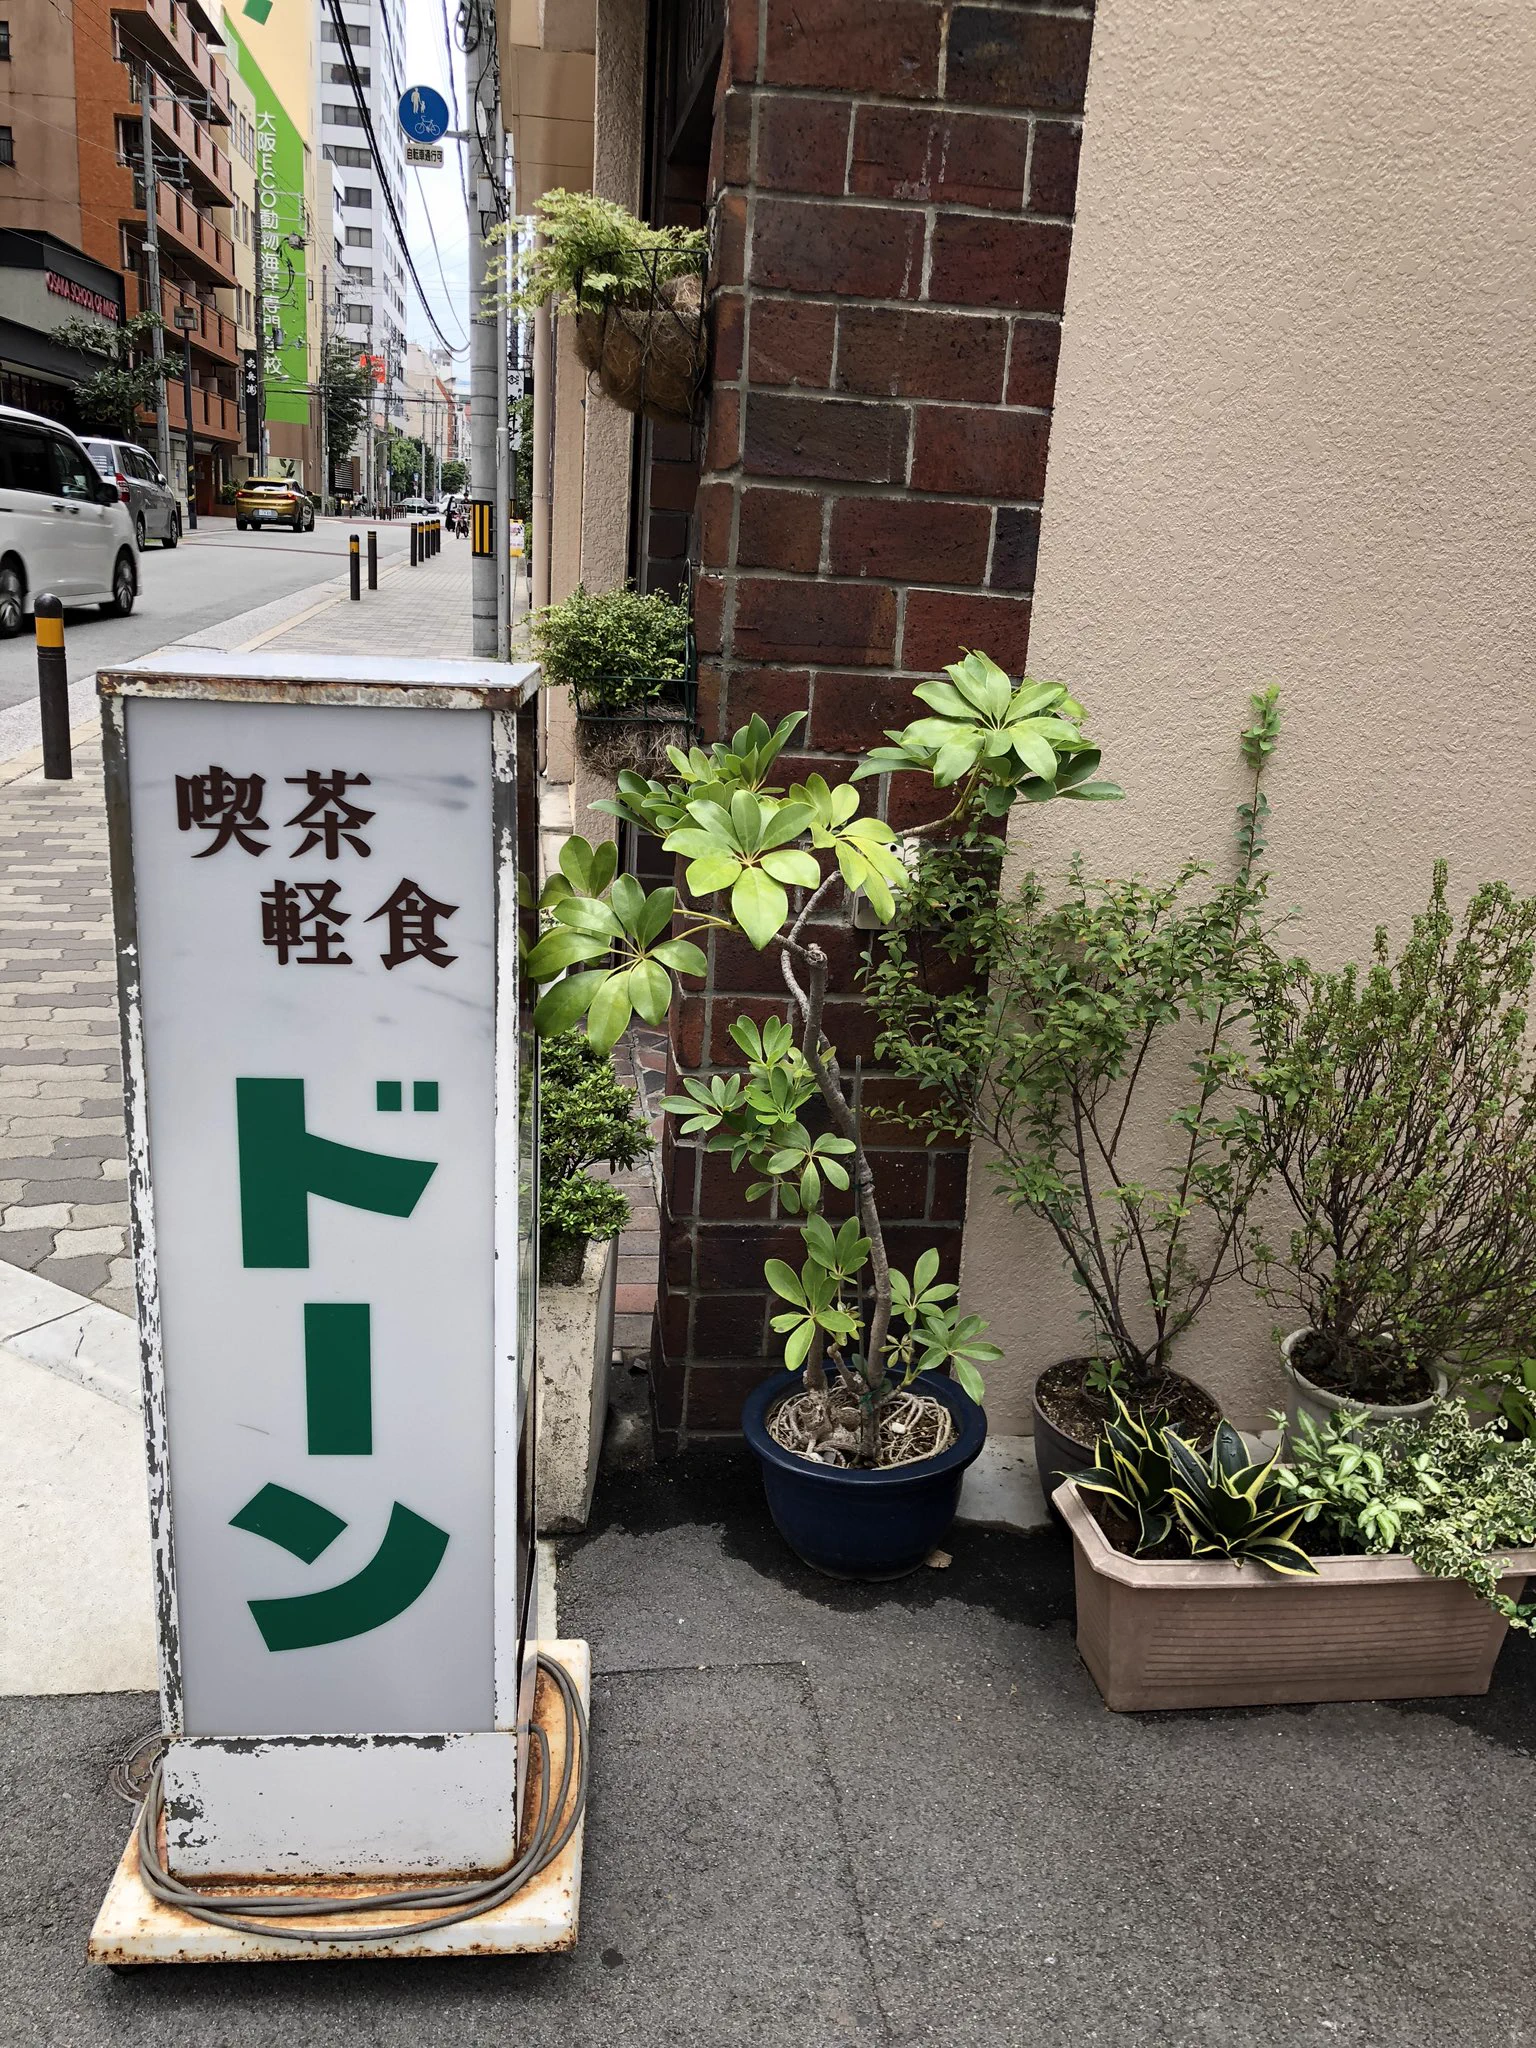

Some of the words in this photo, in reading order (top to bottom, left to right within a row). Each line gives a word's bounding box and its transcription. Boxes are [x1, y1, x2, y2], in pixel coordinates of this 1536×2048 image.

[406, 148, 443, 163] 自転車通行可
[46, 271, 71, 298] OSAKA
[70, 282, 95, 310] SCHOOL
[94, 294, 103, 313] OF
[103, 299, 119, 321] MUSIC
[174, 764, 377, 860] 喫茶
[260, 877, 460, 971] 軽食
[228, 1076, 451, 1653] ドーン
